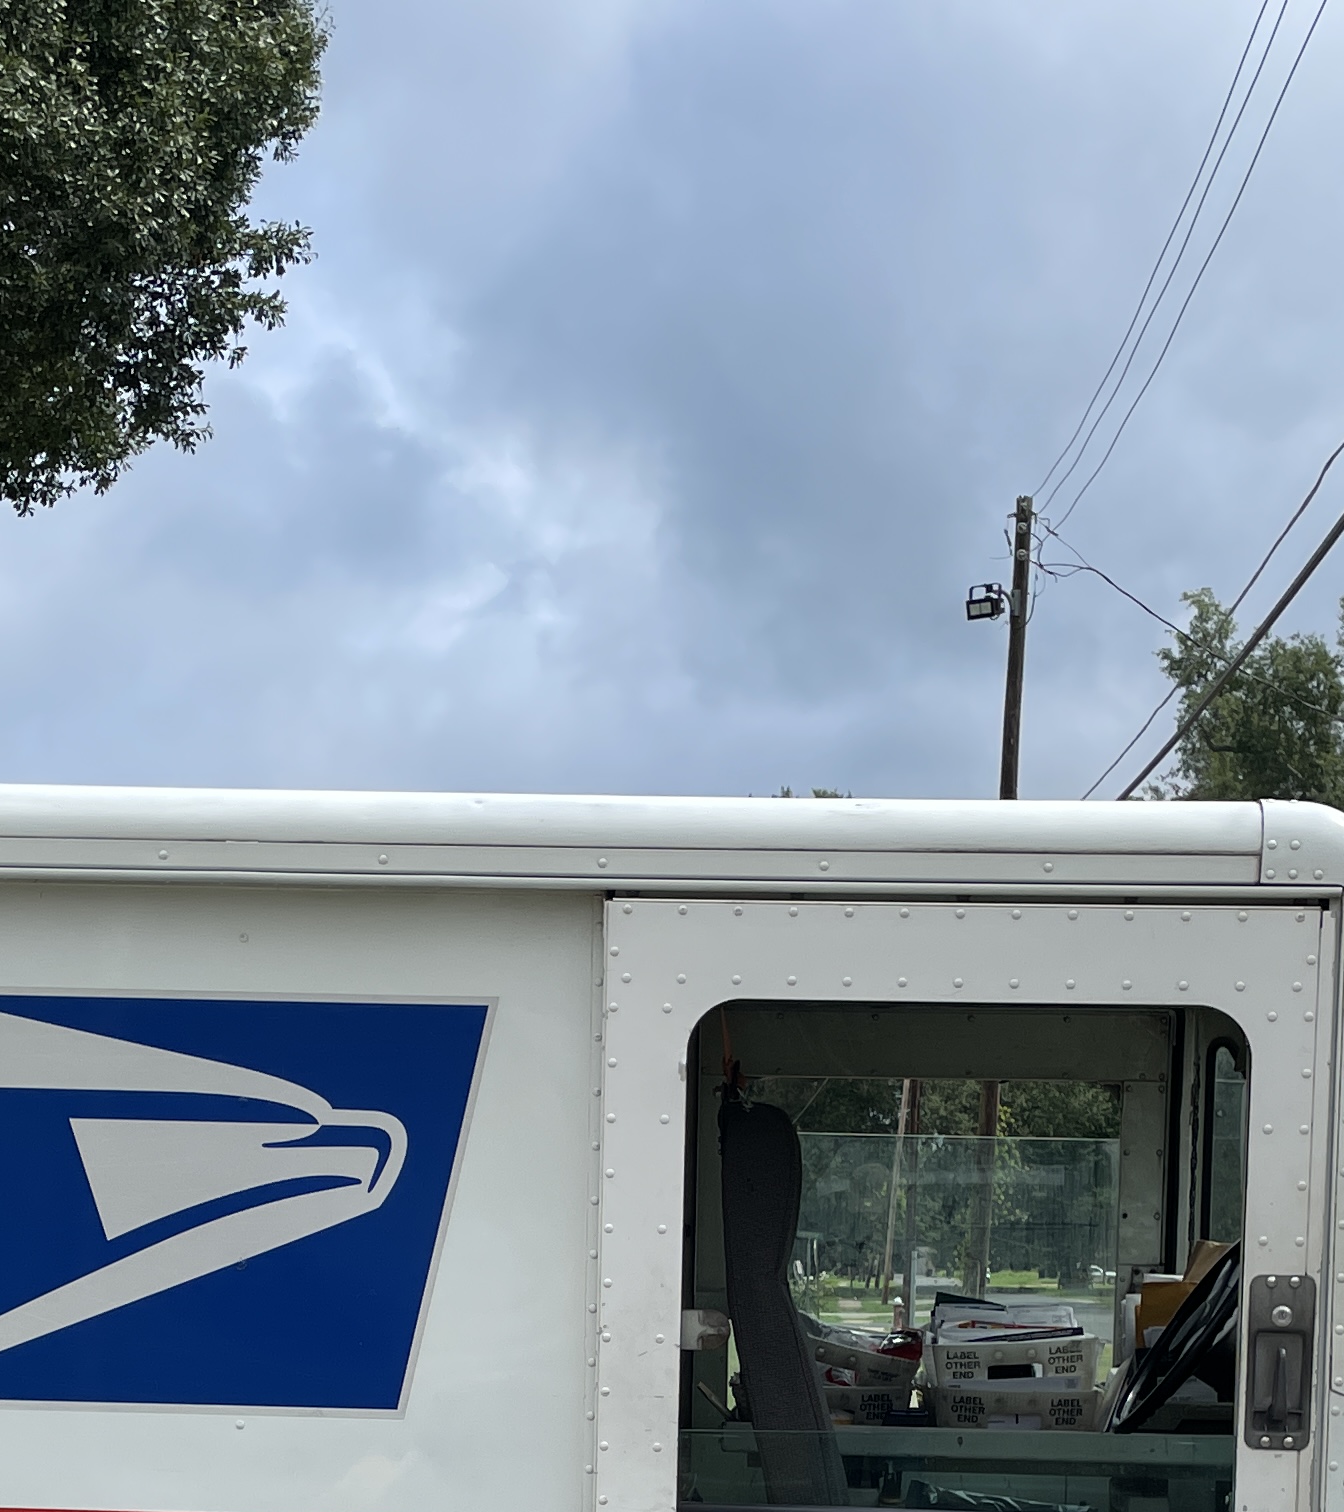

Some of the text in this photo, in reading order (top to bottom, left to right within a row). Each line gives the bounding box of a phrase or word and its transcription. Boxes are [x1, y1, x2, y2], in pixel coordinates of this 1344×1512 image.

[946, 1350, 979, 1360] LABEL
[1048, 1355, 1083, 1365] OTHER
[945, 1361, 981, 1370] OTHER
[1055, 1365, 1076, 1374] END
[952, 1371, 974, 1379] END
[861, 1394, 892, 1403] LABEL
[953, 1395, 985, 1406] LABEL
[1050, 1398, 1082, 1408] LABEL
[951, 1404, 985, 1415] OTHER
[1049, 1407, 1083, 1417] OTHER
[957, 1414, 979, 1423] END
[1055, 1417, 1077, 1426] END
